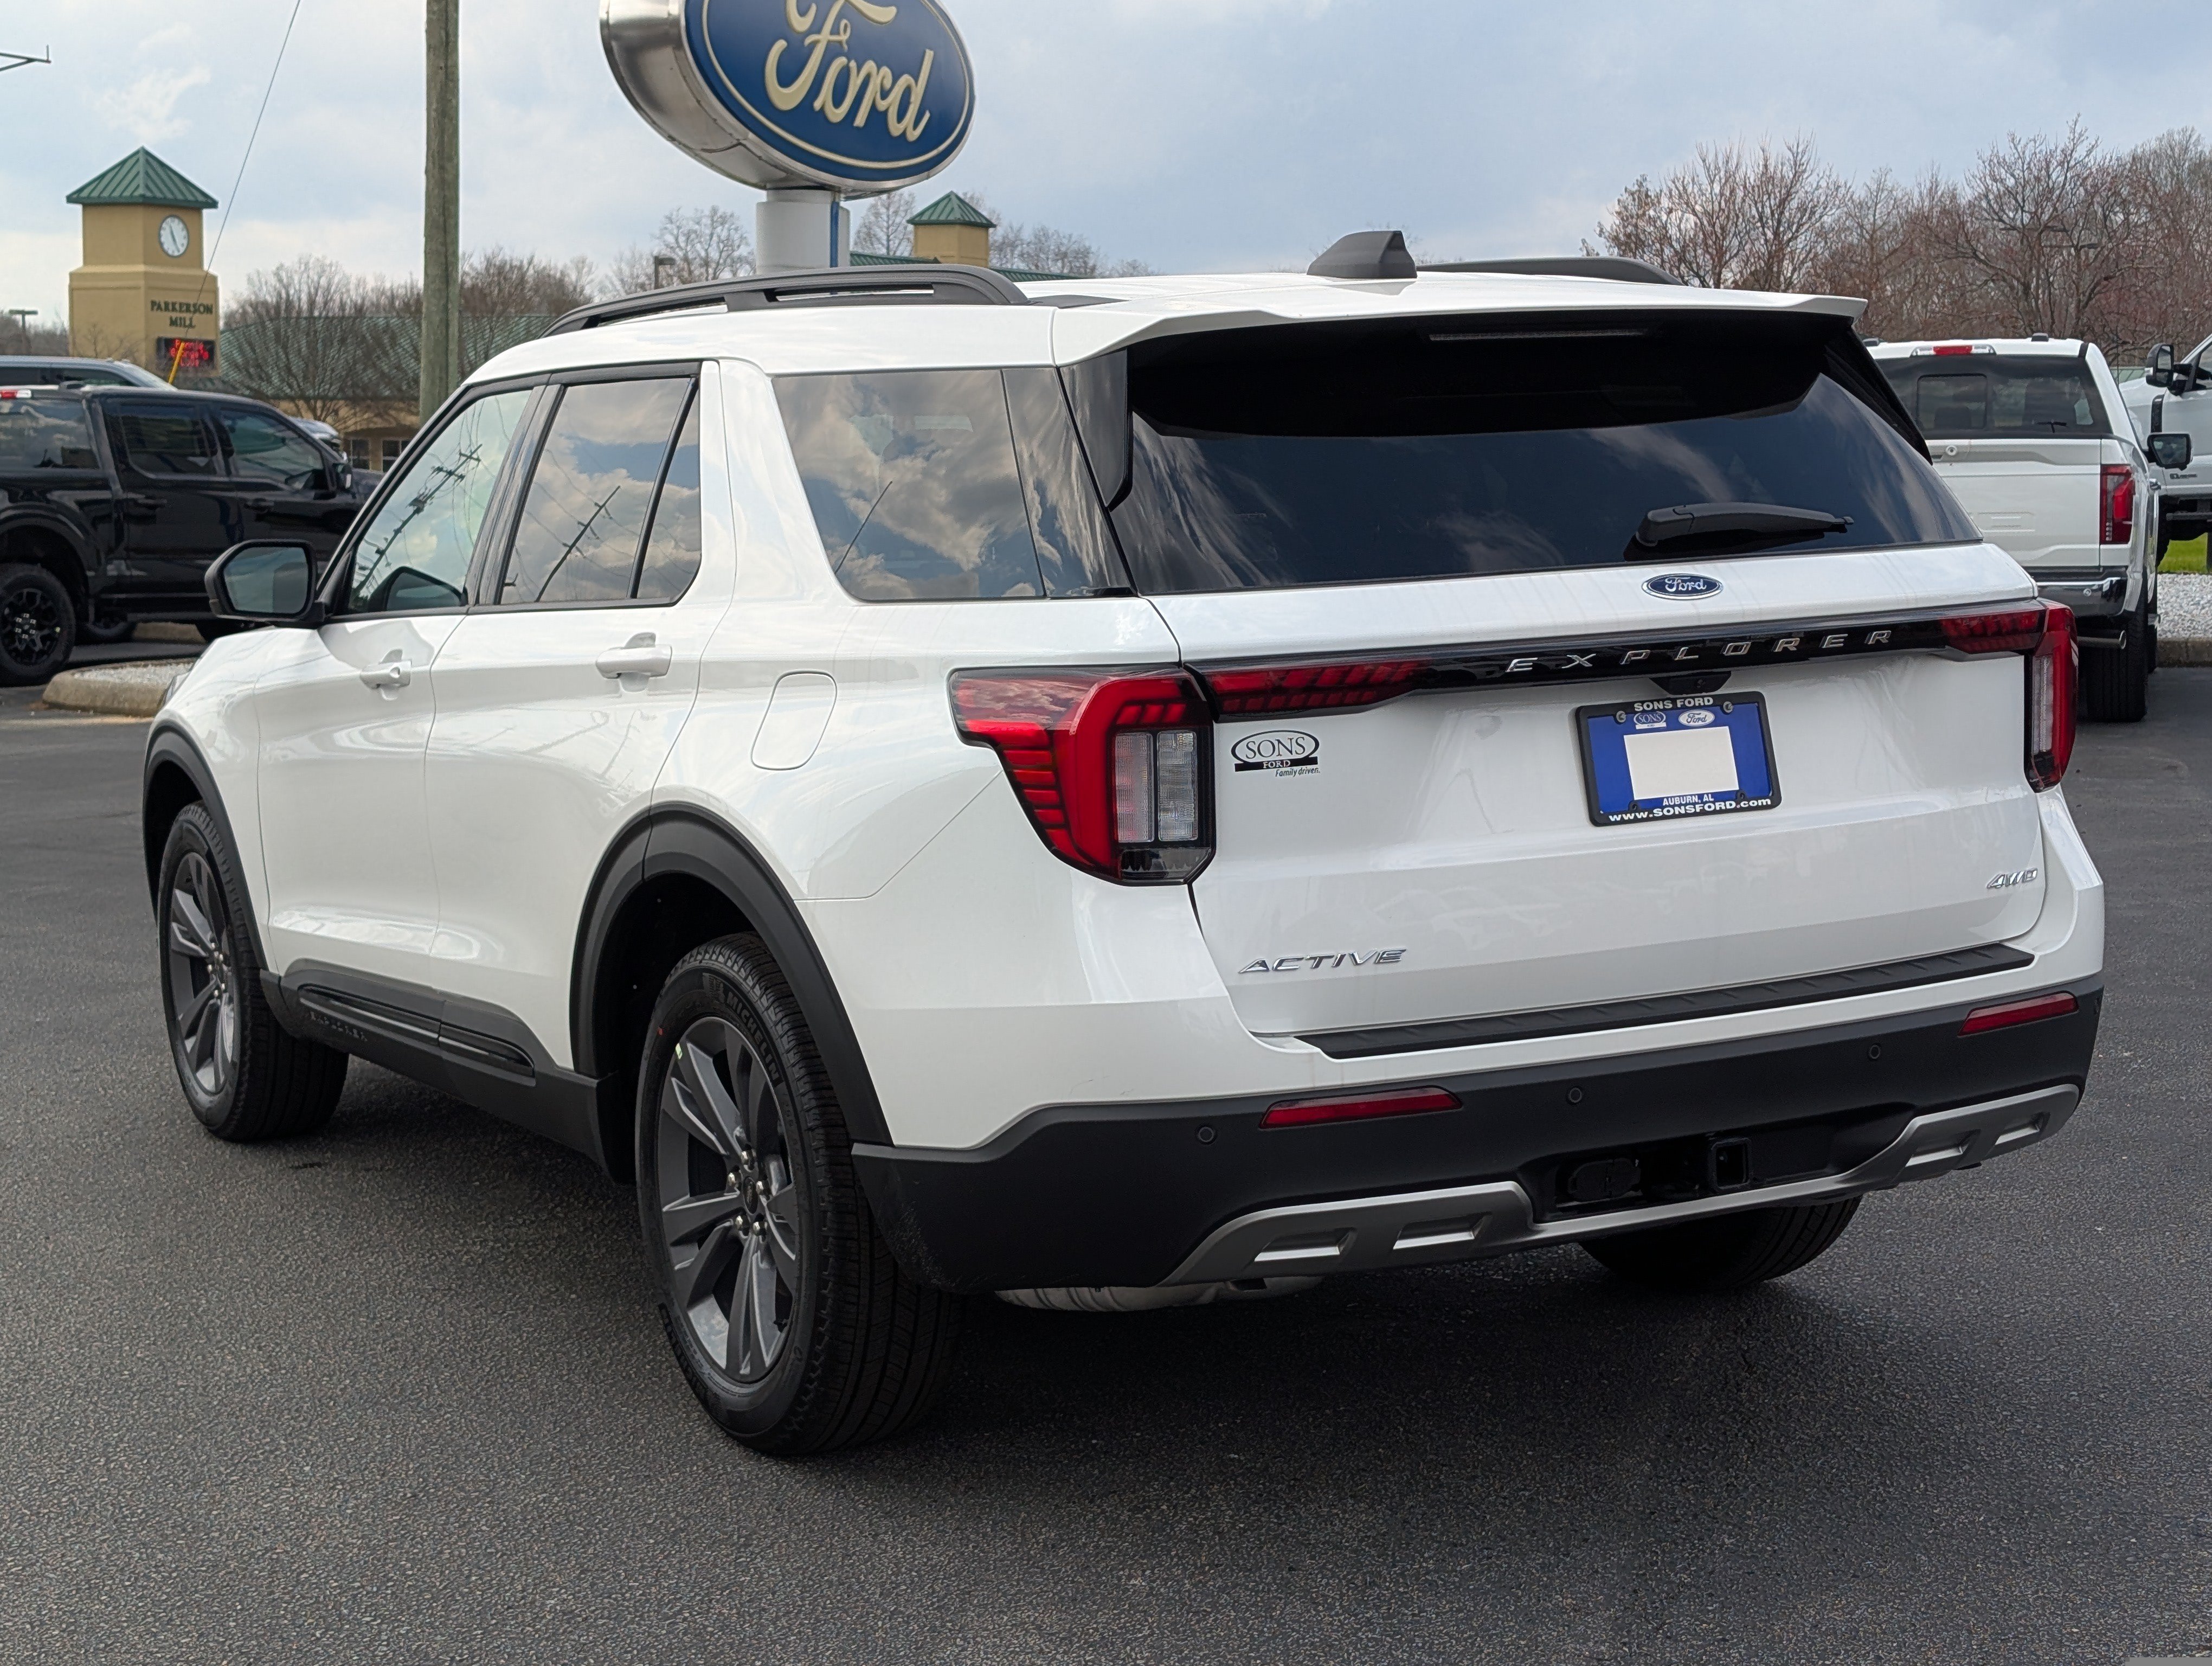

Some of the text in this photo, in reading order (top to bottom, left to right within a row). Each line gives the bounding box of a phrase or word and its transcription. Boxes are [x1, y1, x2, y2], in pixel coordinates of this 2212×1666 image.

[764, 0, 935, 142] Ford
[150, 299, 213, 315] PARKERSON
[169, 315, 196, 329] MILL
[1664, 576, 1707, 593] Ford
[1504, 630, 1892, 673] EXPLORER
[1634, 696, 1714, 712] SONS FORD
[1638, 713, 1662, 723] SONS
[1686, 712, 1707, 724] Ford
[1245, 736, 1306, 759] SONS
[1263, 760, 1291, 769] FORD
[1275, 768, 1297, 778] Family
[1702, 793, 1714, 803] AL
[1609, 798, 1771, 822] www.SONSFORD.com
[1238, 948, 1407, 974] ACTIVE
[726, 990, 783, 1082] MICHELIN
